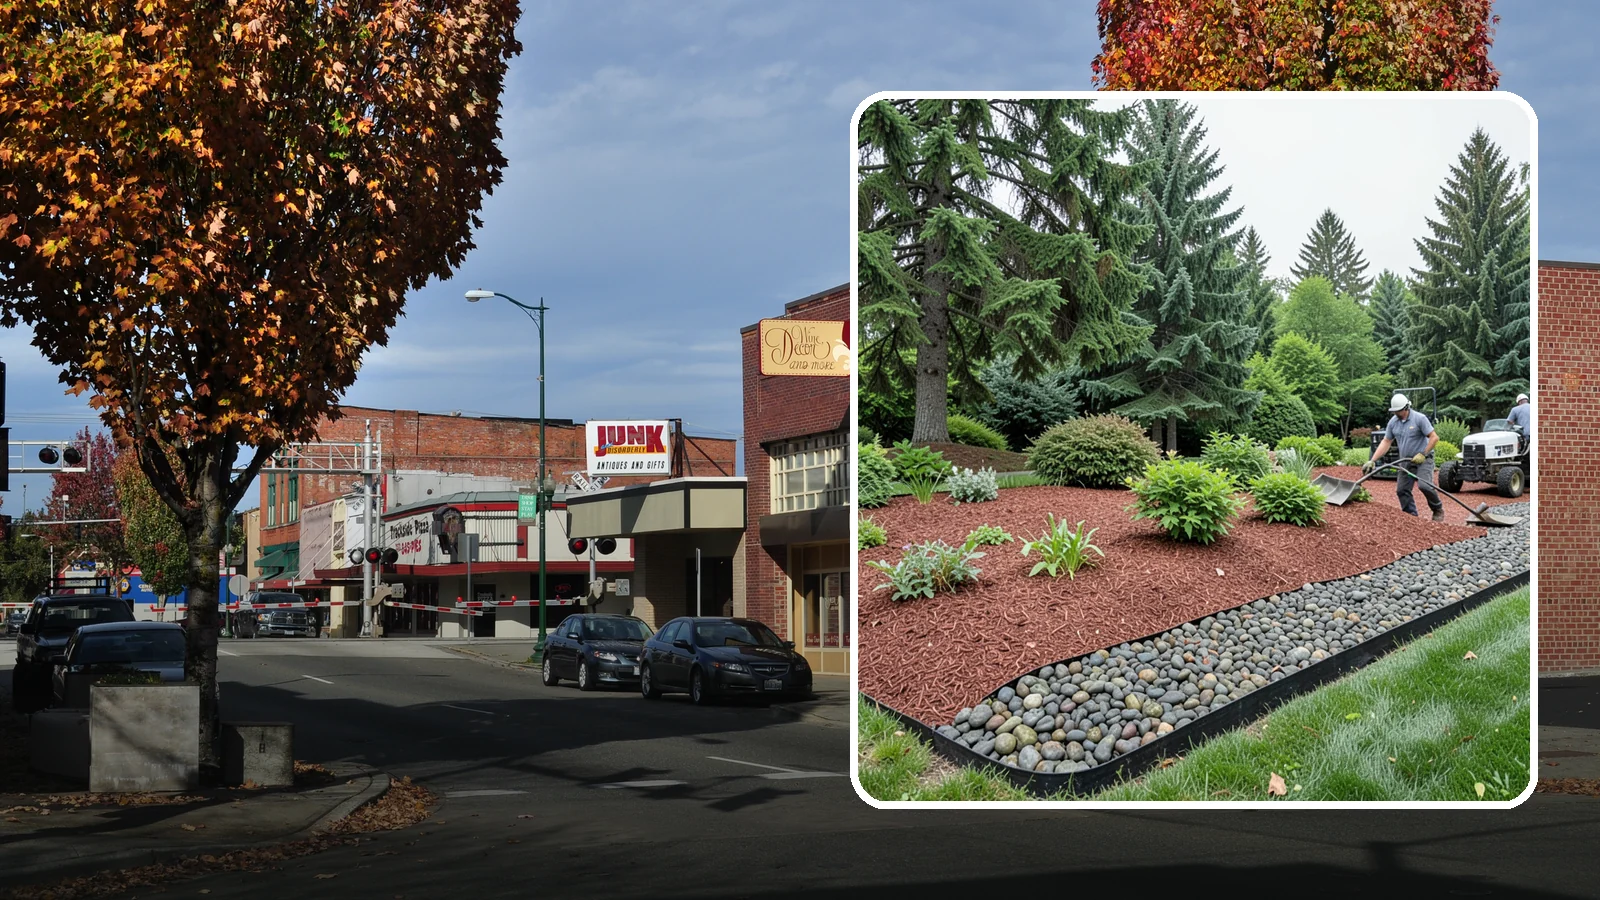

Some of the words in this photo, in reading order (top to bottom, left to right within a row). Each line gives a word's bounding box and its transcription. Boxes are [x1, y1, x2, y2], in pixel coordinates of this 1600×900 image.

[596, 425, 665, 457] JUNK
[607, 446, 646, 454] DISORDERLY
[596, 461, 628, 470] ANTIQUES
[631, 461, 644, 470] AND
[646, 460, 666, 469] GIFTS
[414, 519, 429, 534] Pizza
